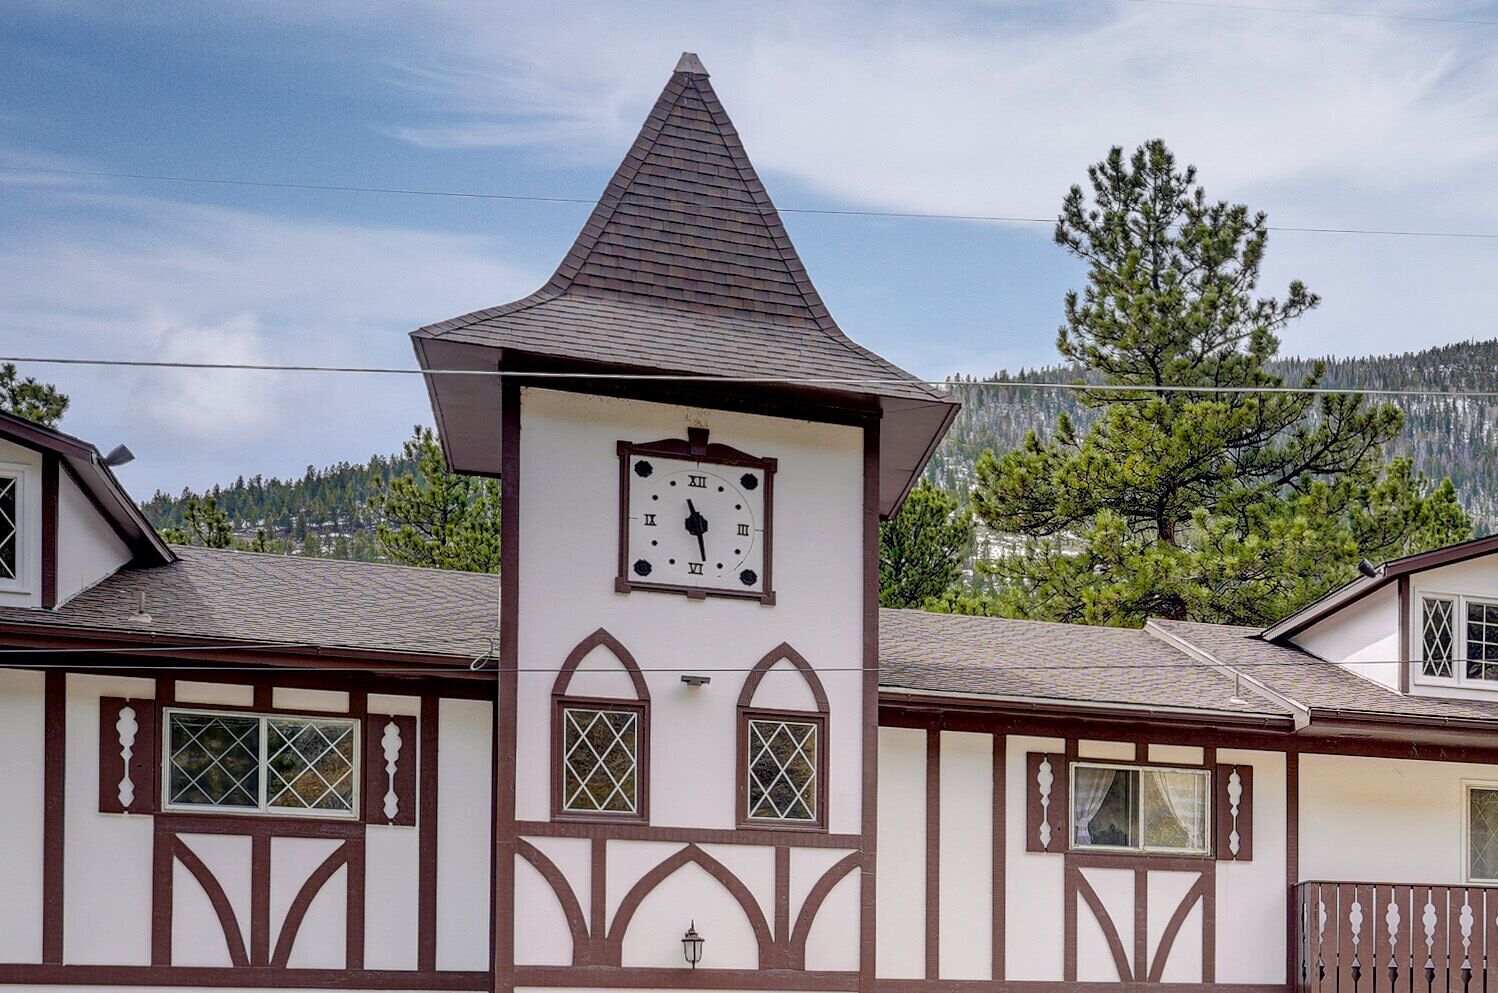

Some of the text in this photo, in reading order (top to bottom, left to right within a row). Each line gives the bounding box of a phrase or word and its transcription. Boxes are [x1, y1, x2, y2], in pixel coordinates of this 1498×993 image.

[688, 475, 707, 488] XII
[644, 514, 657, 526] IX
[737, 524, 749, 536] III
[688, 563, 704, 575] VI
